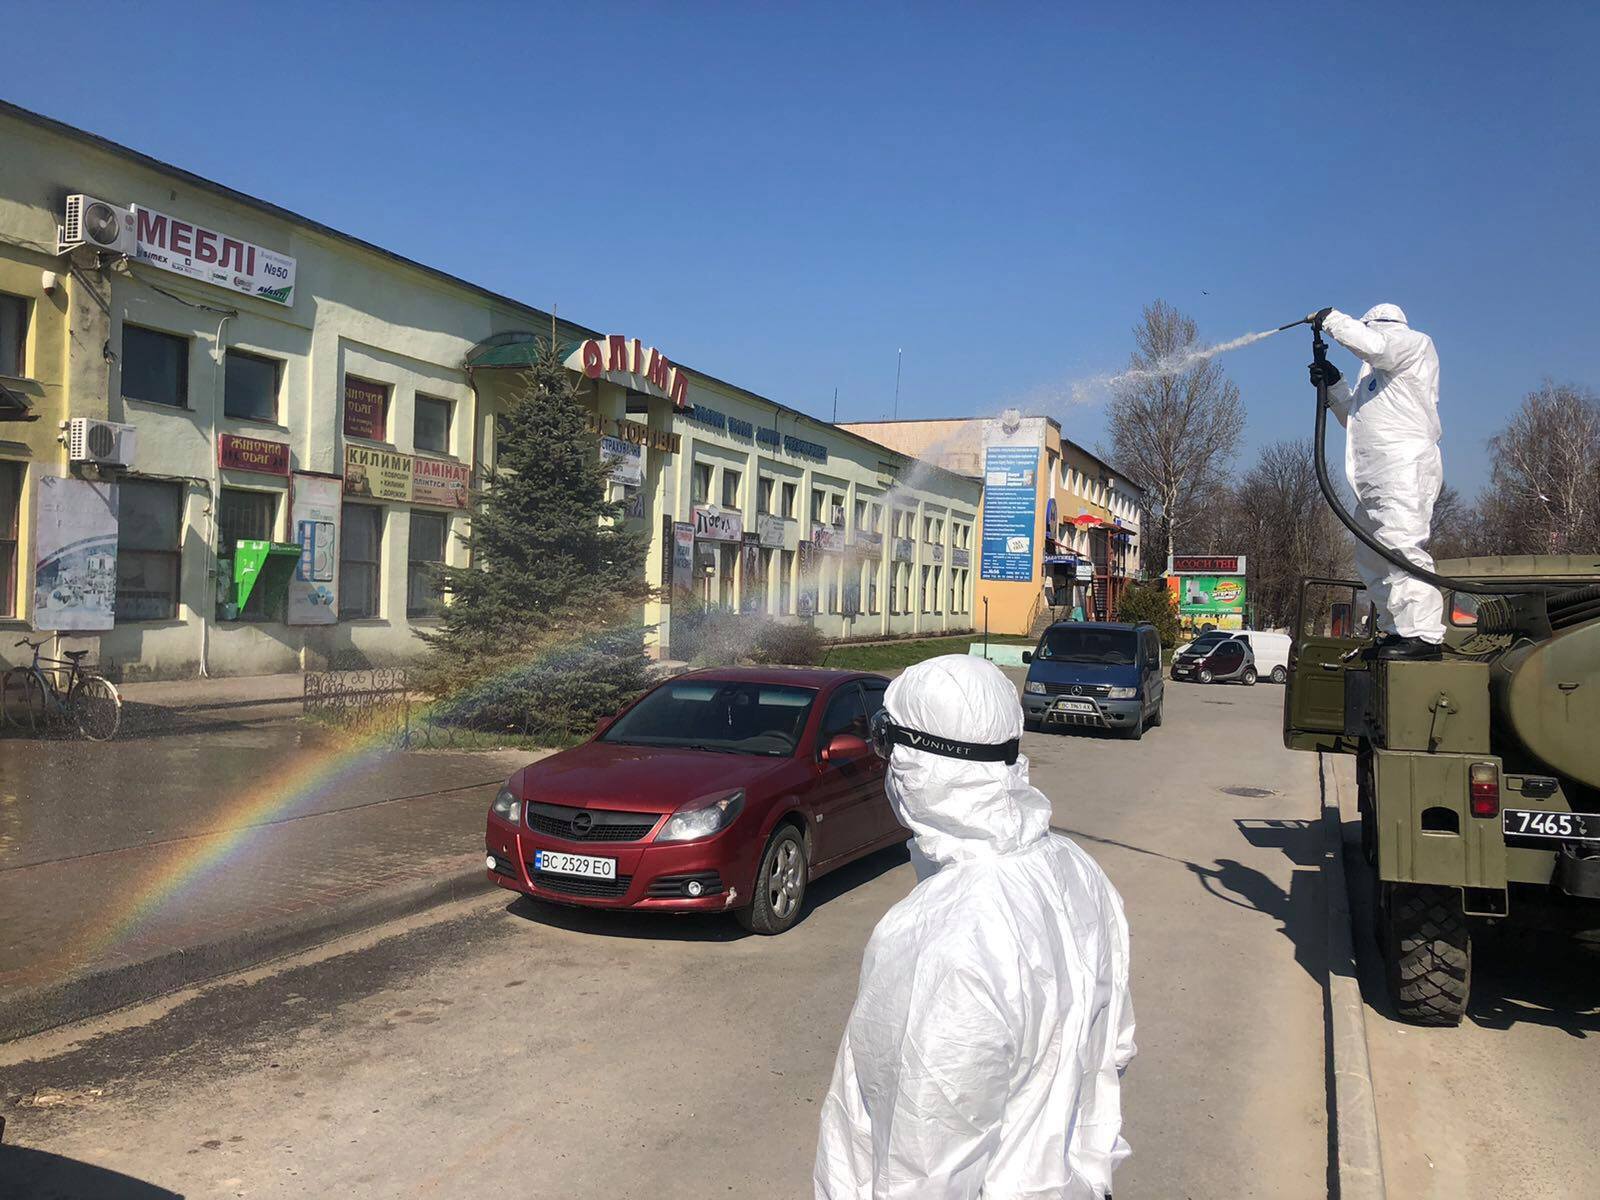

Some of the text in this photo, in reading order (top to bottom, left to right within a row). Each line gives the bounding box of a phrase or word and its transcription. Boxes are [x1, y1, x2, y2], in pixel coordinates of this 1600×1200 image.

[137, 208, 256, 277] МЕБЛІ
[264, 263, 288, 279] №50
[583, 334, 689, 409] ОЛІМП
[350, 449, 411, 472] КИЛИМИ
[414, 461, 468, 481] ЛАМІНАТ
[922, 738, 971, 755] UNIVET
[1517, 812, 1572, 835] 7465
[542, 854, 611, 875] BC 2529 EO
